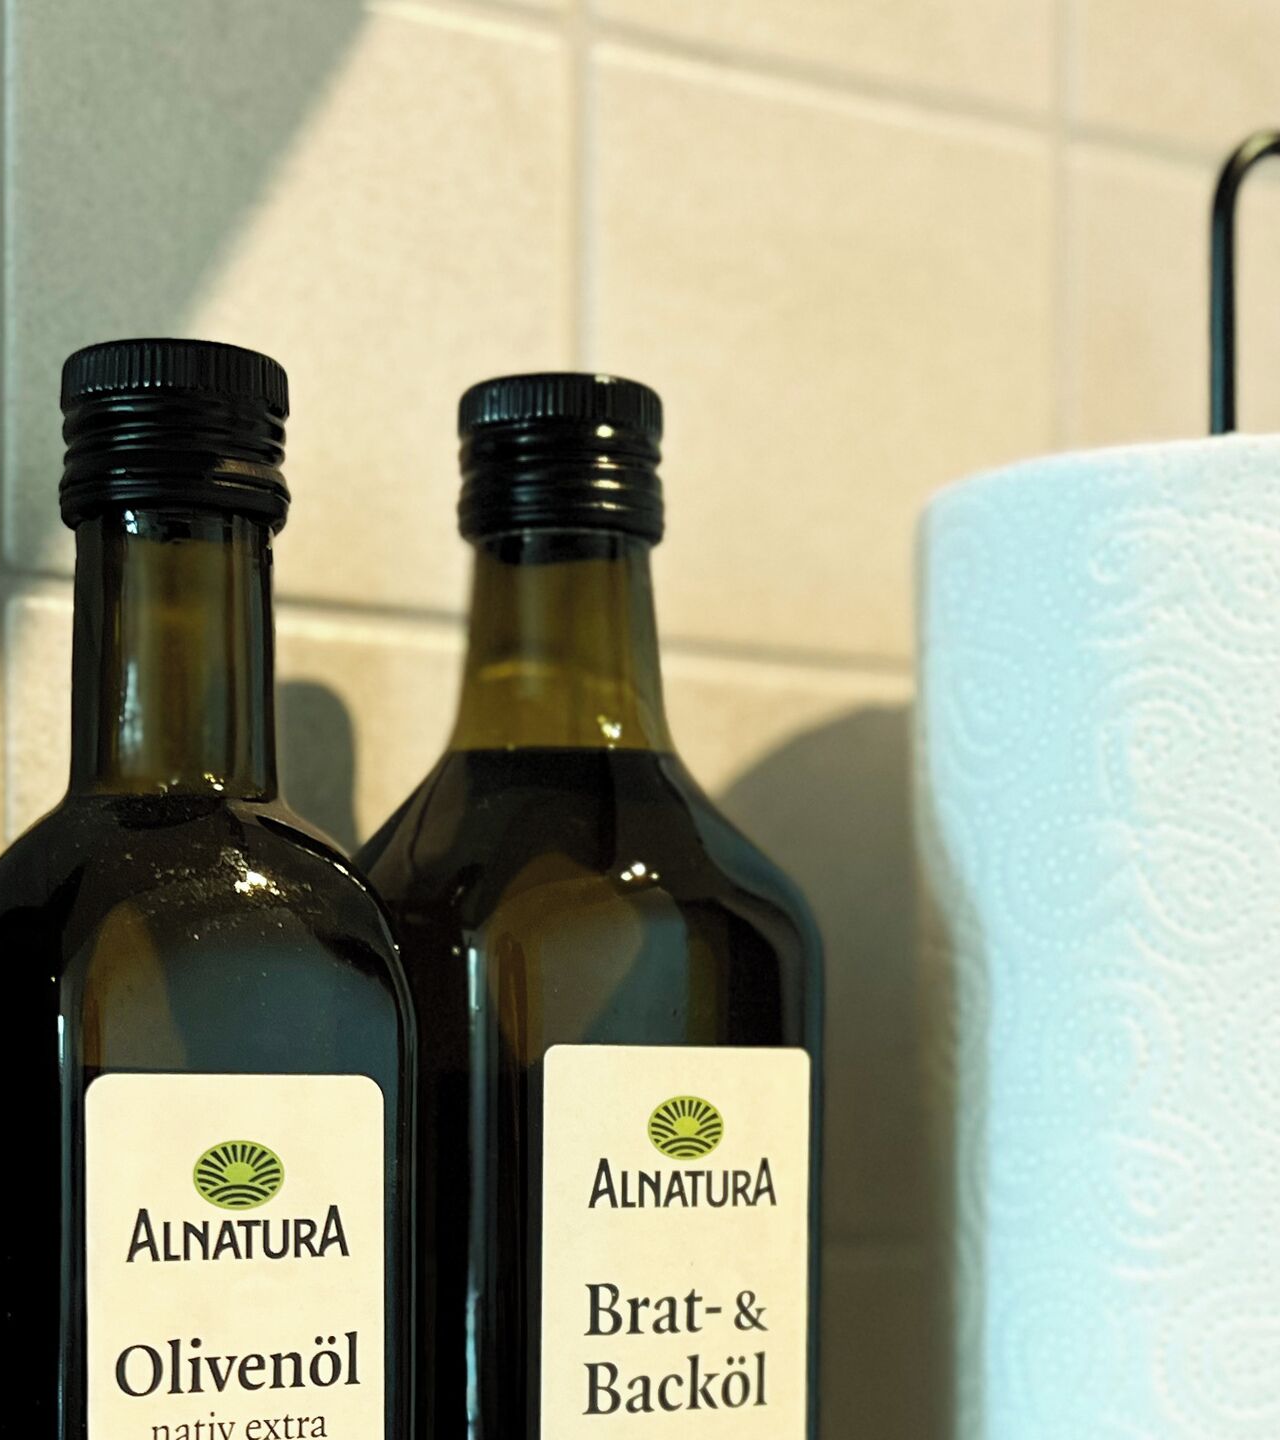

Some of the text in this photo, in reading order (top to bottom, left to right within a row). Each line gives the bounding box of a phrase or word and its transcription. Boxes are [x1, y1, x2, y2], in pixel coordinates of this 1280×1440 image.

[588, 1157, 777, 1208] ALNATURA
[126, 1205, 349, 1262] ALNATURA
[584, 1283, 768, 1336] Brat- &
[115, 1332, 361, 1396] Olivenöl
[582, 1351, 768, 1415] Backöl
